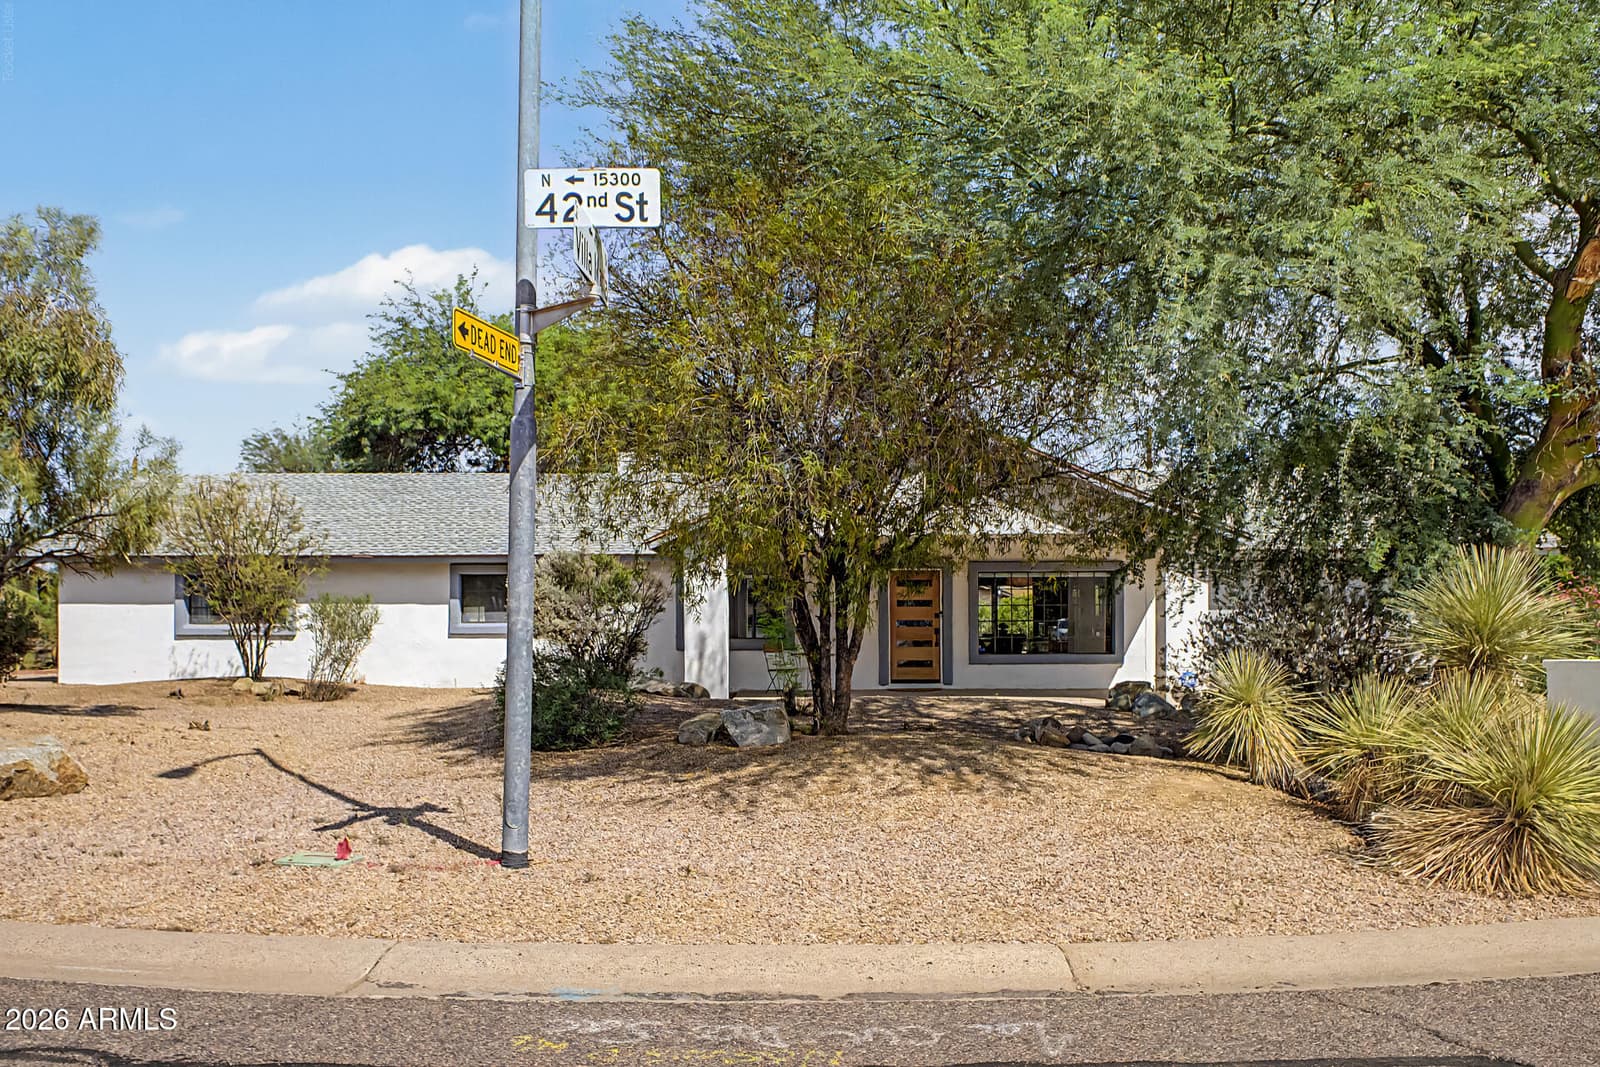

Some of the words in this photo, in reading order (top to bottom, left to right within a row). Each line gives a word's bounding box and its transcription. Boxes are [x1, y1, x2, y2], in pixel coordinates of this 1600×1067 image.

[541, 173, 551, 187] N
[593, 172, 641, 186] 15300
[535, 191, 608, 223] 42nd
[614, 191, 649, 223] St
[470, 324, 497, 355] DEAD
[499, 338, 517, 364] END
